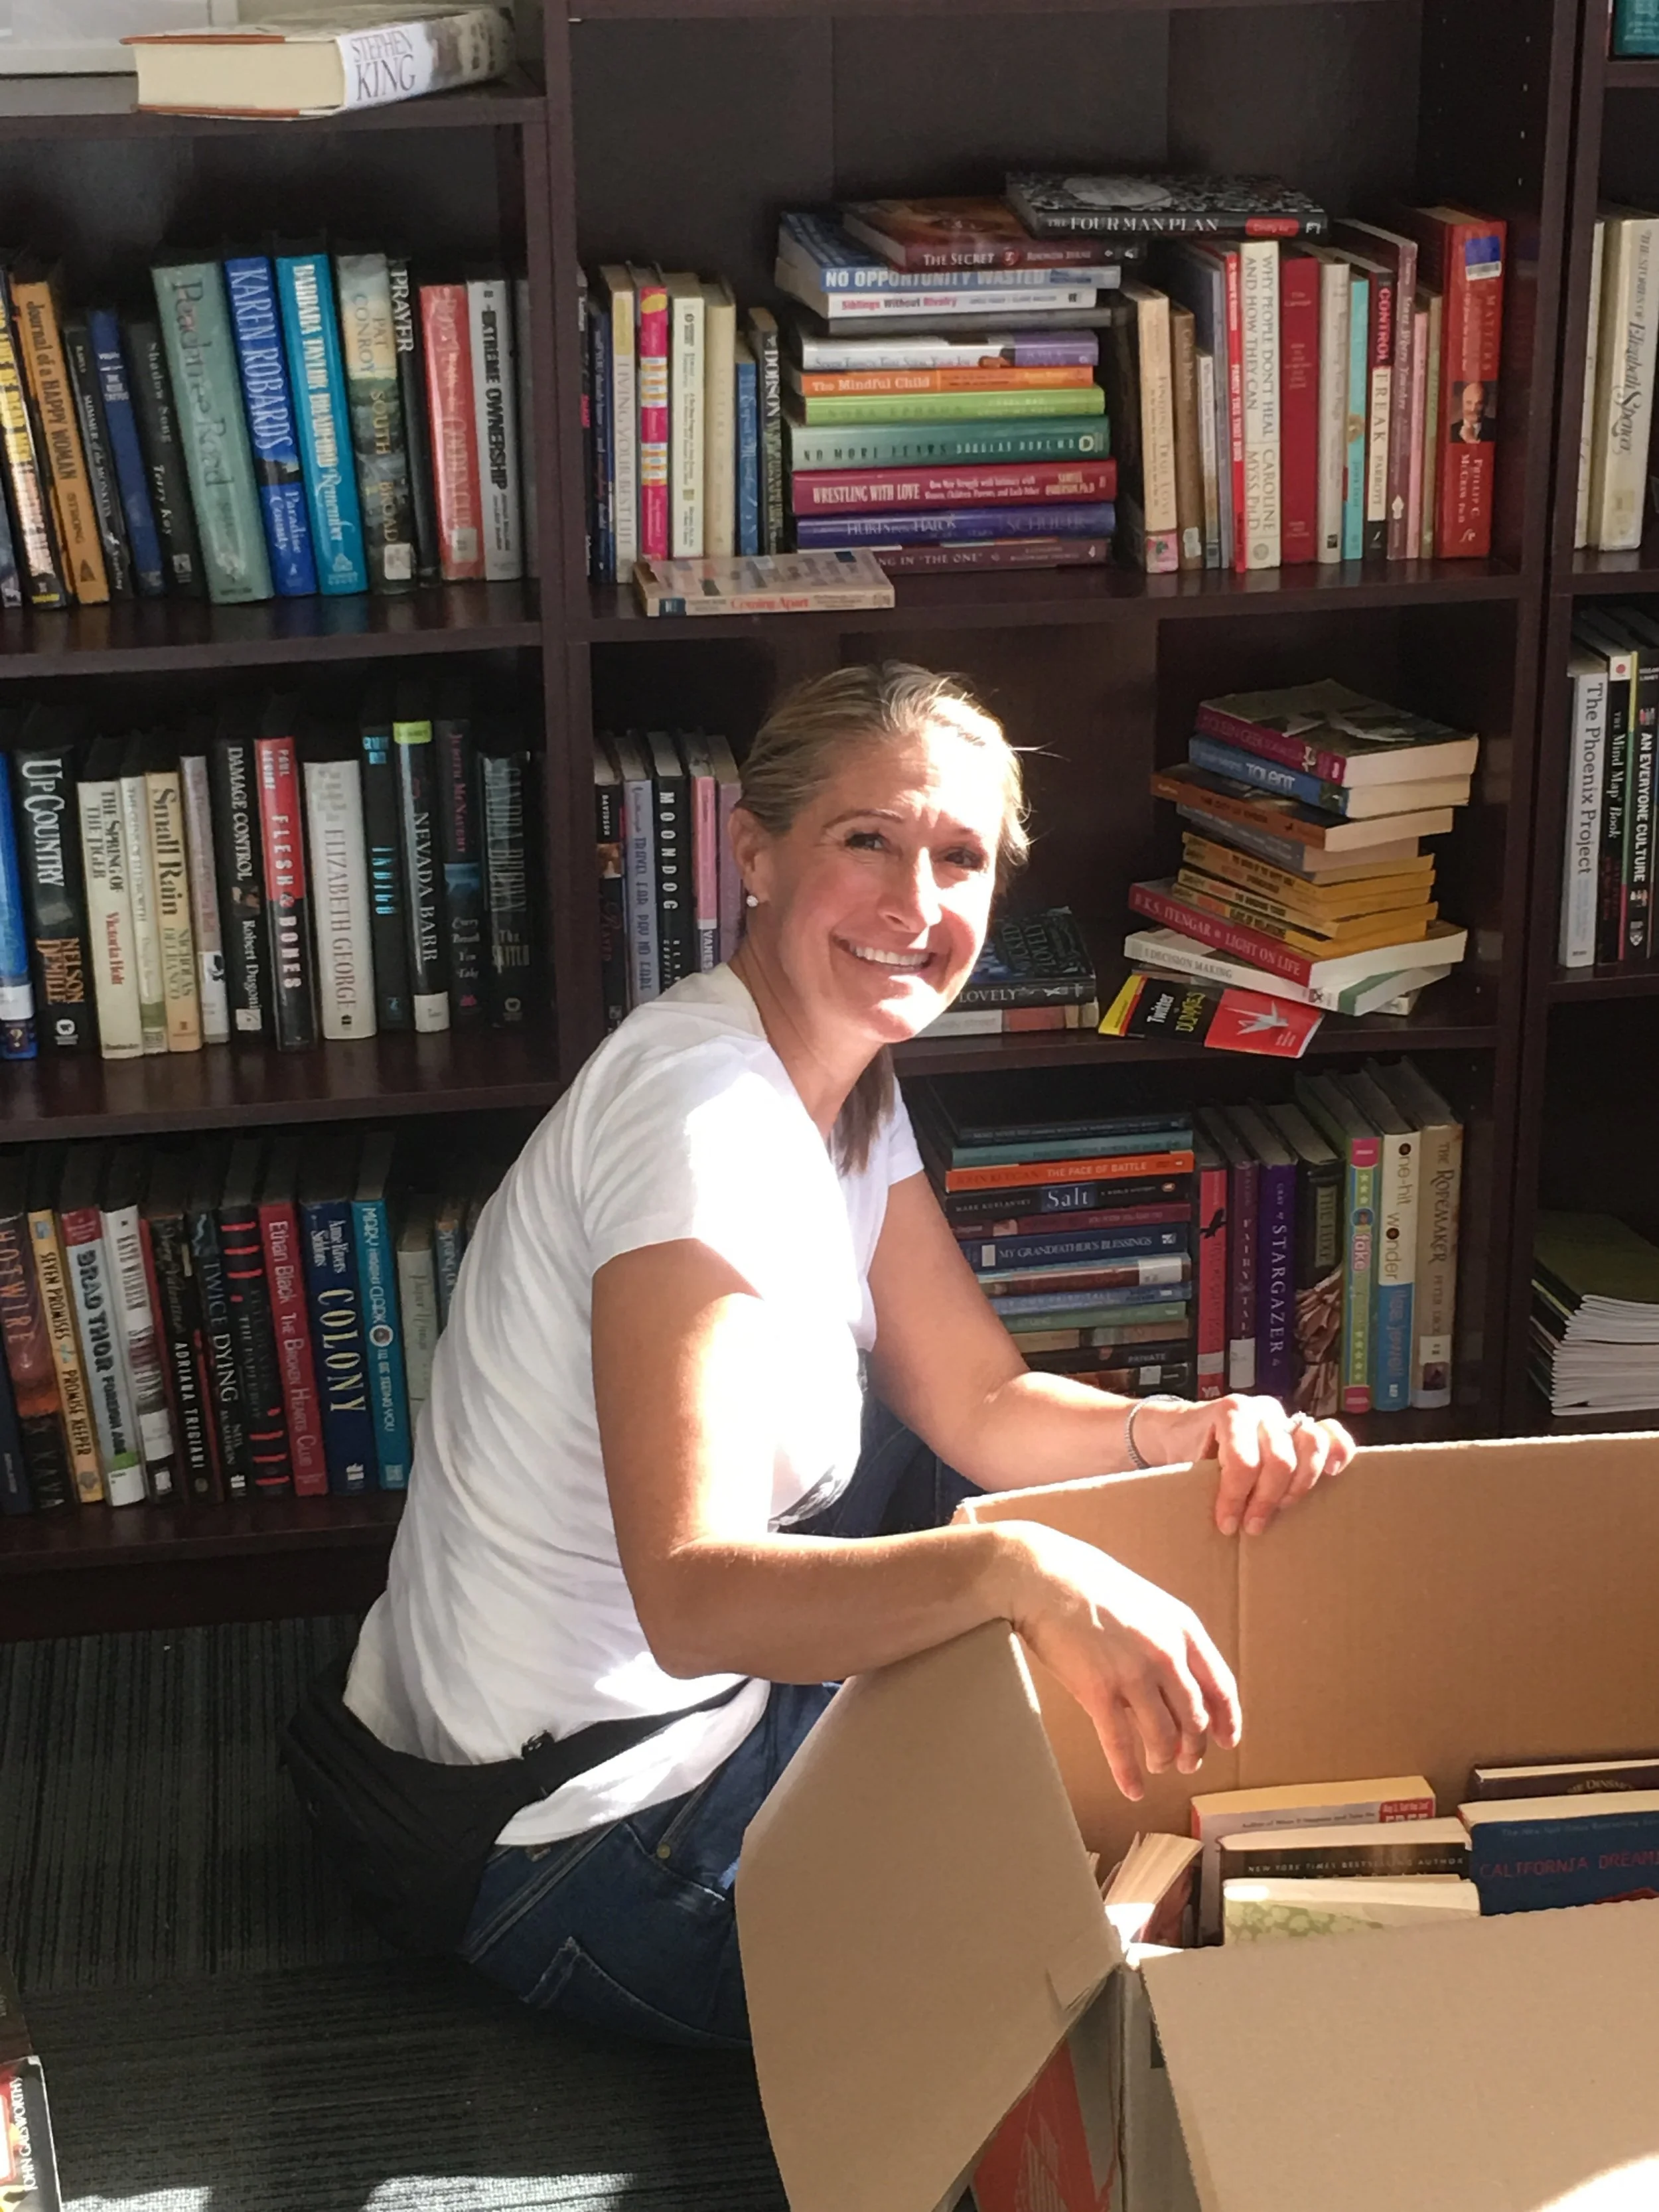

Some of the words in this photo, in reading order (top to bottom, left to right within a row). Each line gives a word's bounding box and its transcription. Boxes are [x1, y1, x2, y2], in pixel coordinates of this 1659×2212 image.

[351, 33, 413, 62] STEPHEN
[356, 54, 417, 102] KING
[1070, 216, 1120, 231] FOUR
[1123, 217, 1165, 231] MAN
[1169, 217, 1219, 231] PLAN
[826, 271, 848, 288] NO
[855, 267, 971, 287] OPPORTUNITY
[977, 267, 1045, 285] WASTED
[924, 253, 948, 265] THE
[950, 252, 995, 265] SECRET
[1246, 256, 1258, 291] AND
[1262, 255, 1273, 290] WHY
[230, 268, 275, 340] KAREN
[293, 263, 322, 334] BARBARA
[390, 269, 414, 352] PRAYER
[841, 300, 881, 311] Siblings
[884, 298, 920, 309] Without
[923, 296, 958, 309] Rivalry
[1246, 295, 1258, 335] HOW
[1262, 295, 1275, 344] PEOPLE
[26, 301, 50, 352] Journal
[352, 294, 375, 373] CONROY
[372, 314, 389, 350] PAT
[481, 310, 500, 385] EXTREME
[1378, 287, 1391, 363] CONTROL
[1483, 295, 1496, 371] MATTERS
[303, 336, 328, 390] TAYLOR
[1230, 363, 1242, 393] FAMILY
[1246, 336, 1258, 376] THEY
[1263, 350, 1275, 397] DON'T
[1624, 321, 1647, 390] Elizabeth
[42, 380, 64, 425] HAPPY
[171, 281, 211, 414] Peachtree
[200, 417, 234, 488] Road
[244, 347, 293, 450] ROBARDS
[764, 350, 781, 417] DOBSON
[812, 380, 834, 392] The
[838, 377, 891, 391] Mindful
[895, 376, 930, 389] Child
[1246, 378, 1258, 411] CAN
[1374, 372, 1388, 443] FREAK
[309, 393, 337, 469] BRADFORD
[370, 390, 392, 455] SOUTH
[484, 387, 508, 490] OWNERSHIP
[1263, 400, 1275, 438] HEAL
[1612, 386, 1644, 456] Spencer
[51, 429, 77, 480] WOMAN
[804, 449, 824, 462] NO
[833, 446, 878, 460] MORE
[153, 465, 166, 502] Terry
[813, 485, 868, 505] WRESTLING
[870, 484, 895, 502] WITH
[897, 482, 920, 500] LOVE
[1263, 448, 1276, 532] CAROLINE
[67, 493, 85, 544] STRONG
[271, 496, 287, 550] County
[284, 490, 301, 553] Paradise
[378, 482, 398, 543] BROAD
[901, 555, 914, 565] IN
[1585, 681, 1603, 722] The
[277, 748, 289, 776] PAUL
[1580, 725, 1602, 804] Phoenix
[1611, 735, 1626, 767] Mind
[1640, 732, 1652, 751] AN
[23, 759, 63, 794] UP
[228, 747, 248, 816] DAMAGE
[1636, 753, 1652, 822] EVERYONE
[86, 805, 102, 834] THE
[101, 790, 115, 818] THE
[153, 787, 181, 855] Small
[486, 767, 524, 842] SANDRA
[1607, 804, 1623, 839] Book
[24, 796, 65, 887] COUNTRY
[88, 837, 106, 879] TIGER
[103, 820, 122, 872] SPRING
[232, 817, 253, 881] CONTROL
[271, 814, 294, 887] FLESH
[412, 812, 433, 907] NEVADA
[634, 837, 648, 876] TRAVEL
[660, 791, 679, 911] MOONDOG
[1575, 808, 1597, 874] Project
[1633, 824, 1648, 883] CULTURE
[109, 874, 124, 893] OF
[158, 861, 183, 916] Rain
[323, 829, 352, 933] ELIZABETH
[489, 848, 526, 913] BROWN
[106, 911, 121, 958] Victoria
[242, 919, 257, 960] Robert
[279, 916, 301, 990] BONES
[419, 907, 437, 963] BARR
[1225, 932, 1258, 957] LIGHT
[1260, 947, 1277, 963] ON
[1277, 954, 1301, 977] LIFE
[35, 937, 64, 1005] DEMILLE
[58, 937, 84, 1003] NELSON
[109, 958, 125, 986] Holt
[177, 928, 193, 997] NICHOLAS
[332, 936, 358, 1012] GEORGE
[640, 961, 652, 991] FARE
[1194, 959, 1233, 980] MAKING
[959, 988, 1016, 1003] LOVELY
[1146, 993, 1175, 1023] Twitter
[1046, 1167, 1066, 1178] THE
[1068, 1165, 1094, 1177] FACE
[1096, 1164, 1109, 1173] OF
[1111, 1161, 1148, 1173] BATTLE
[1396, 1142, 1412, 1205] one-hit
[1437, 1143, 1451, 1165] THE
[1046, 1187, 1089, 1209] Salt
[1430, 1169, 1455, 1263] ROPEMAKER
[268, 1220, 290, 1262] Ethan
[362, 1207, 380, 1246] MARY
[999, 1248, 1017, 1258] MY
[1018, 1242, 1100, 1258] GRANDFATHER'S
[1101, 1236, 1152, 1250] BLESSINGS
[1384, 1212, 1401, 1280] wonder
[0, 1226, 36, 1343] HOTWIRE
[40, 1251, 61, 1286] SEVEN
[77, 1249, 105, 1309] BRAD
[202, 1258, 229, 1328] TWICE
[275, 1264, 295, 1304] Black
[1269, 1222, 1287, 1355] STARGAZER
[47, 1285, 71, 1341] PROMISES
[281, 1313, 295, 1334] THE
[370, 1285, 387, 1325] CLARK
[89, 1311, 115, 1373] THOR
[283, 1338, 305, 1387] BROKEN
[318, 1289, 366, 1412] COLONY
[1386, 1324, 1405, 1378] jewell
[174, 1341, 194, 1403] ADRIANA
[212, 1333, 239, 1403] DYING
[61, 1368, 83, 1416] PROMISE
[72, 1417, 92, 1455] KEEPER
[102, 1375, 122, 1430] FOREIGN
[289, 1387, 312, 1432] HEARTS
[383, 1408, 396, 1432] YOU
[183, 1408, 205, 1469] TRIGIANI
[296, 1432, 316, 1469] CLUB
[1341, 1860, 1413, 1870] BESTSELLING
[1417, 1858, 1464, 1866] AUTHOR
[1479, 1856, 1590, 1879] CALIFORNIA
[9, 2076, 33, 2158] GALSWORTHY
[20, 2159, 38, 2191] JOHN
